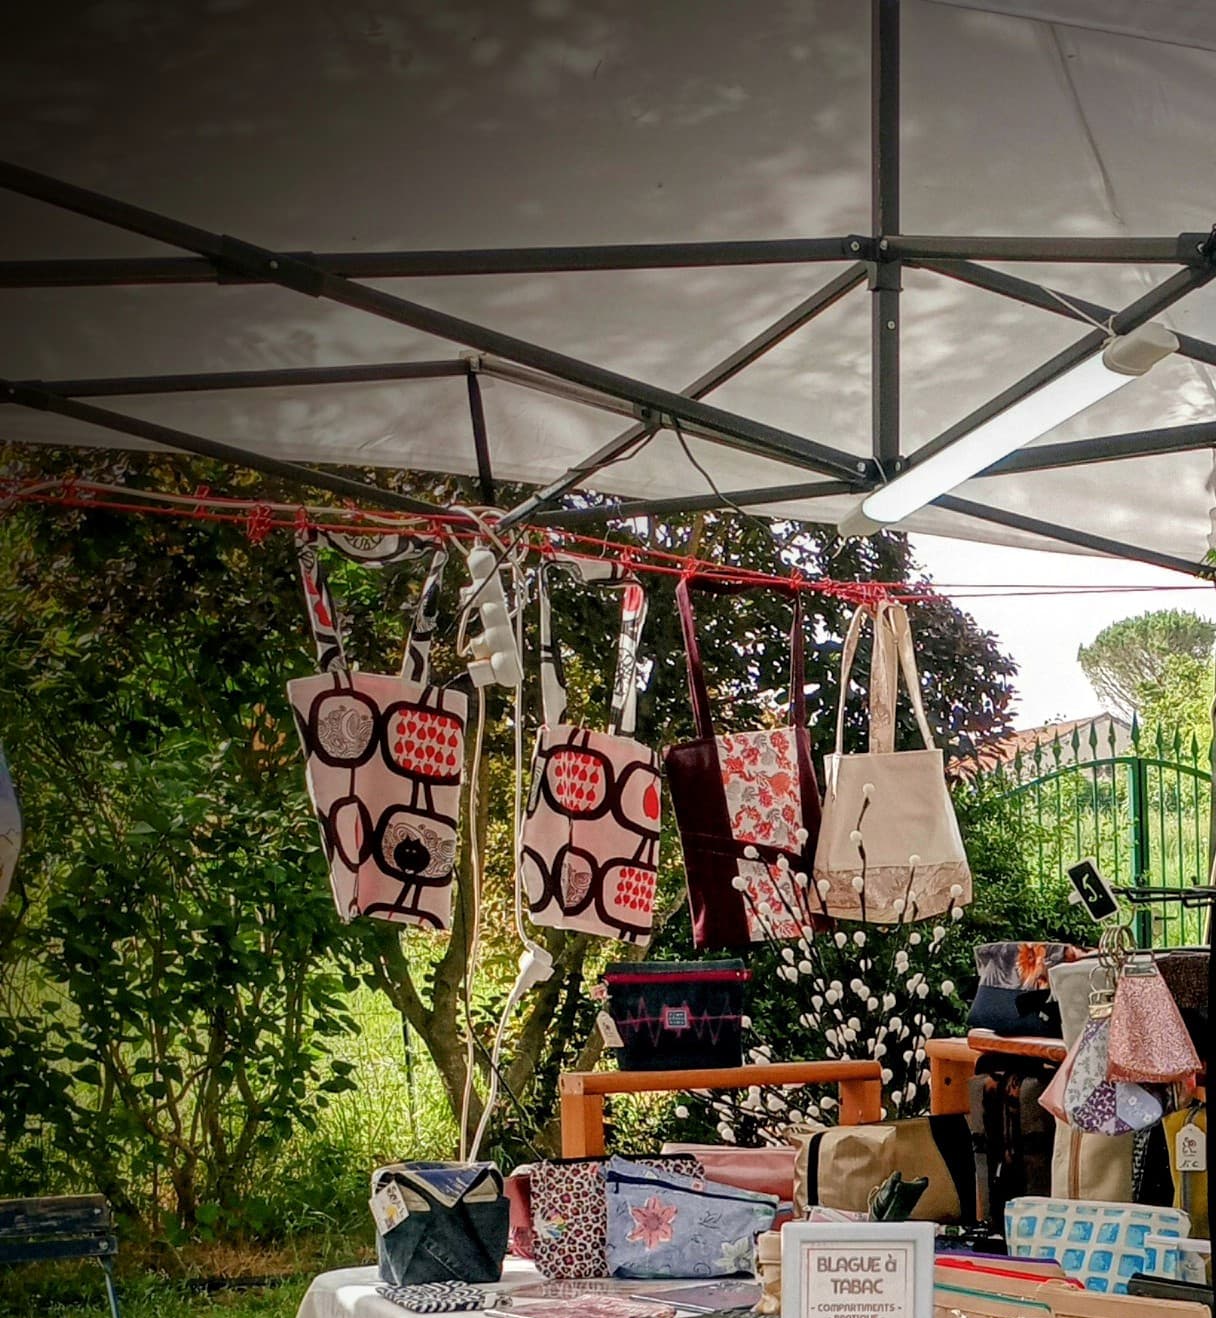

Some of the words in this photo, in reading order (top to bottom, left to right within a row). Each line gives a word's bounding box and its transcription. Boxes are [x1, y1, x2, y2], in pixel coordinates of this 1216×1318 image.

[817, 1256, 881, 1273] BLAGUE
[885, 1253, 897, 1273] à
[830, 1278, 884, 1294] TABAC
[817, 1303, 895, 1312] COMPARTIMENTS
